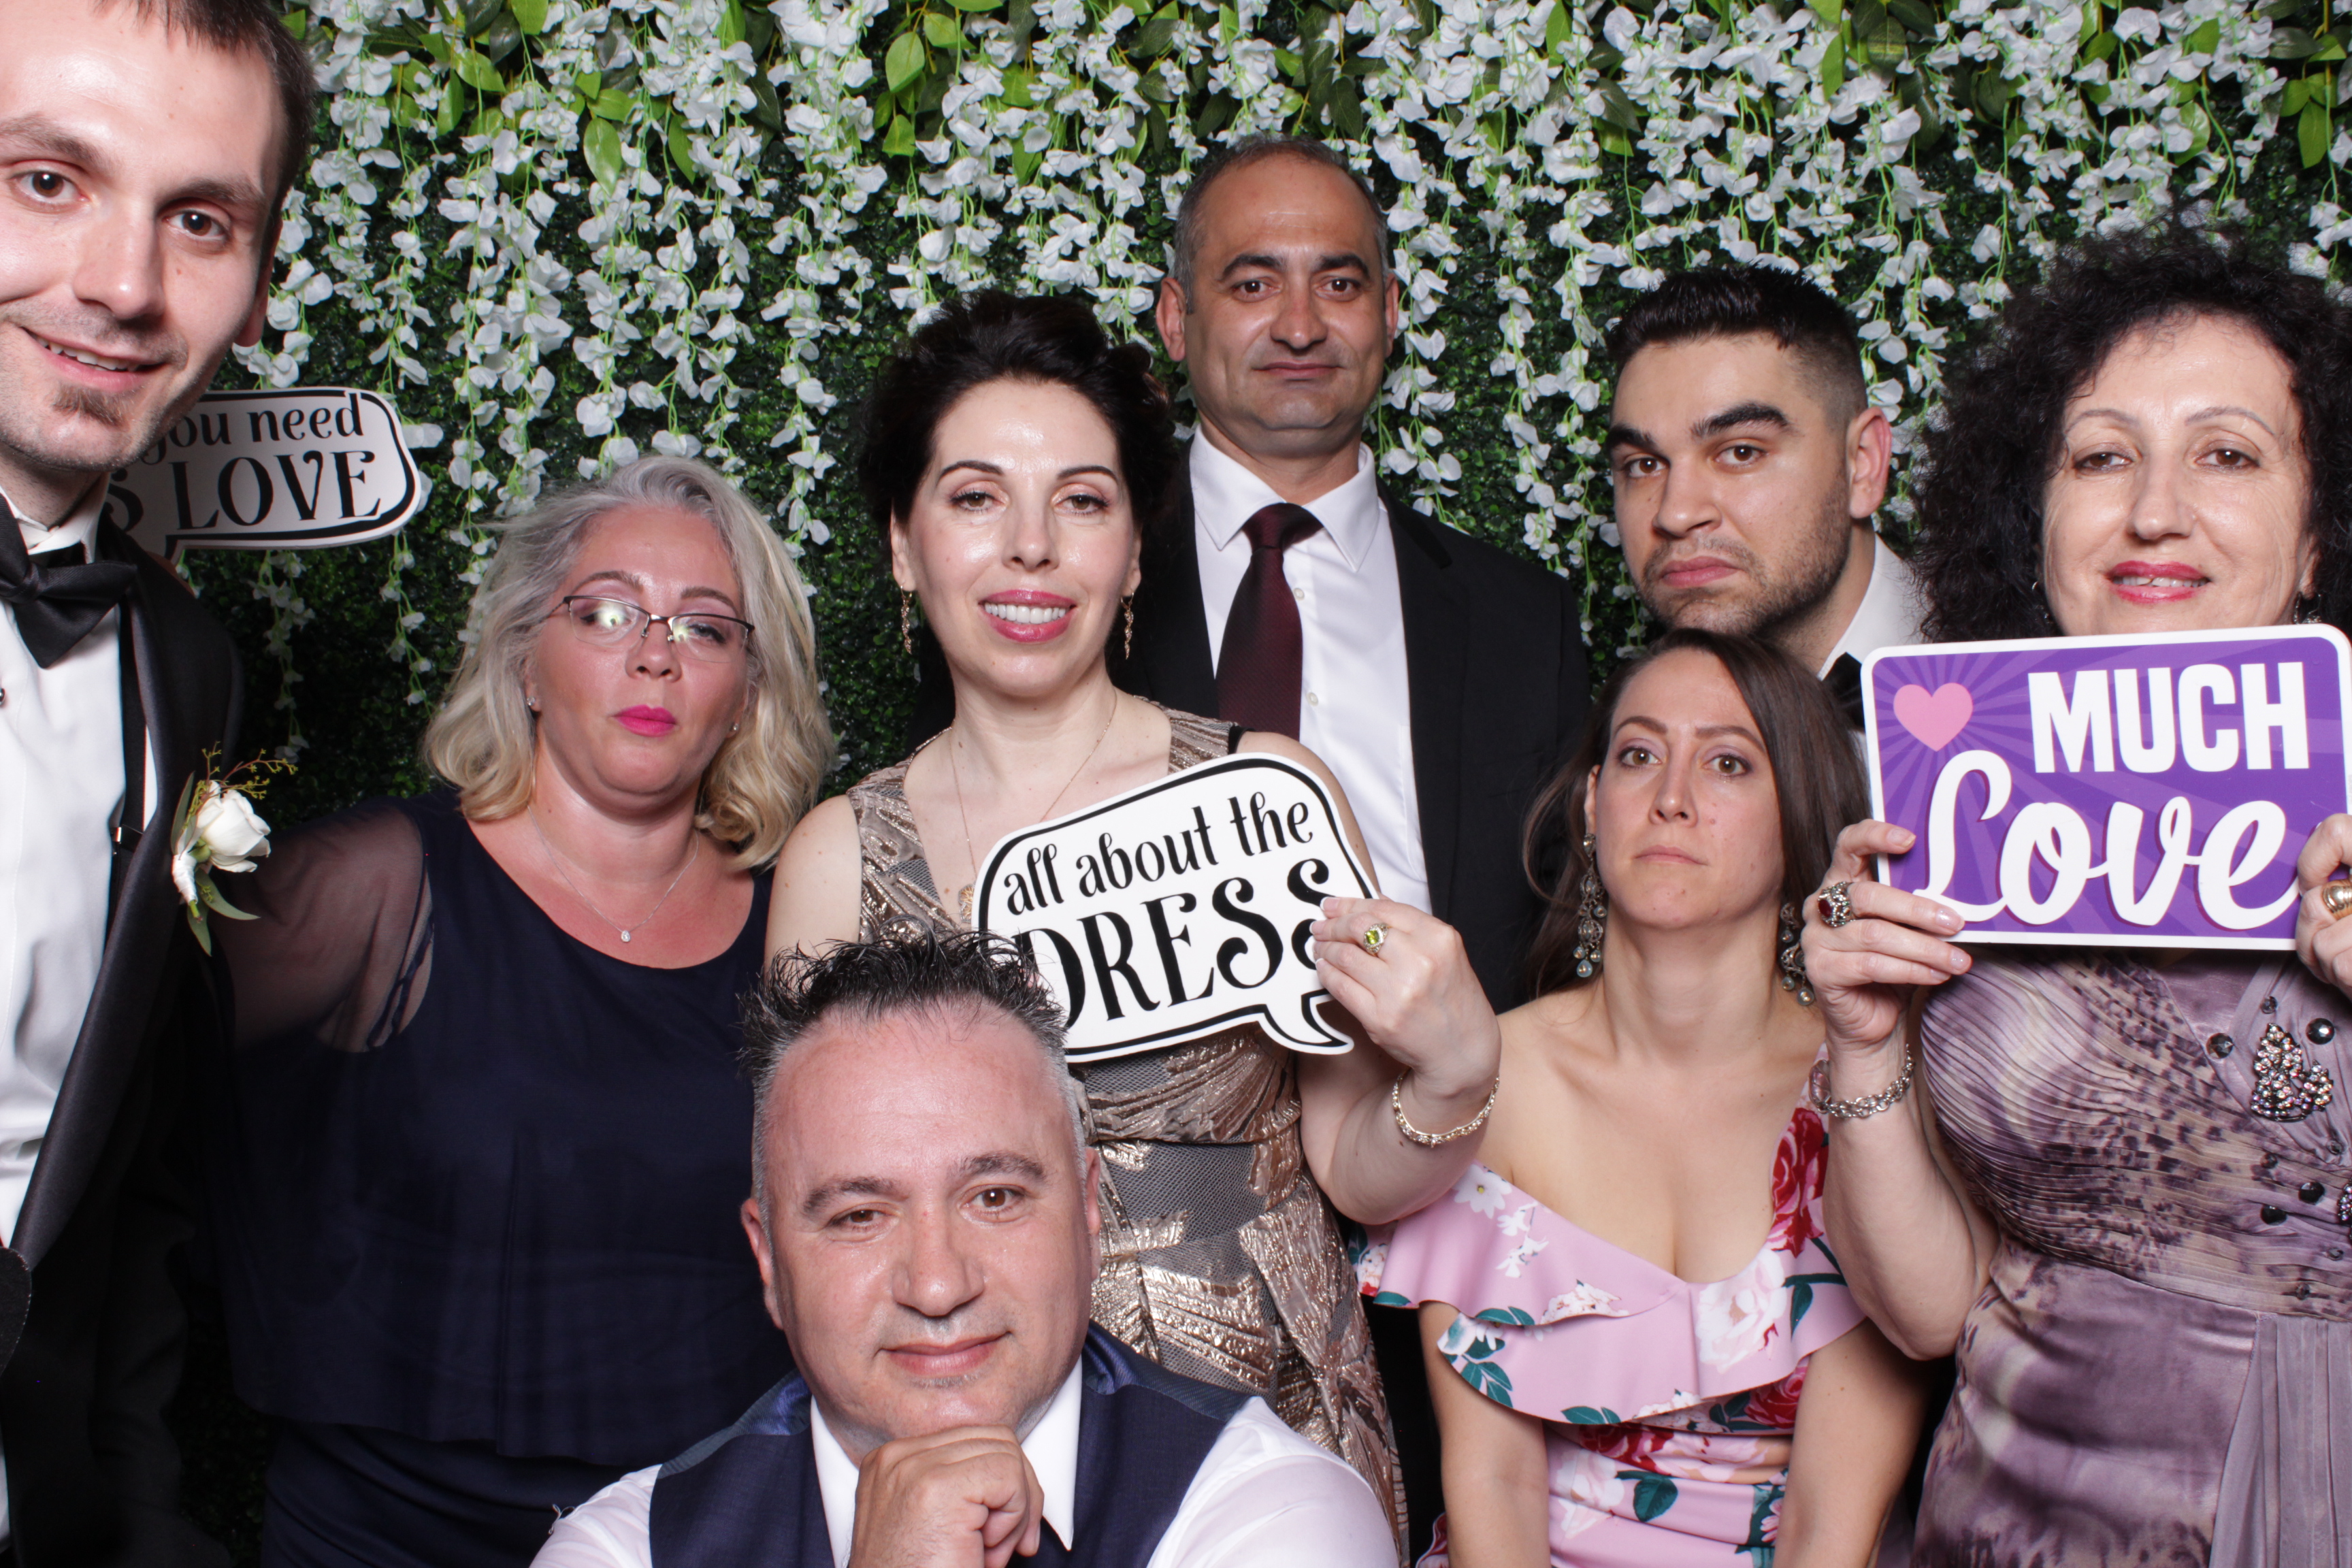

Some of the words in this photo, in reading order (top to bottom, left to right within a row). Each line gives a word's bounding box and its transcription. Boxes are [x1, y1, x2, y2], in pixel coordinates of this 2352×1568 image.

[247, 392, 364, 443] need
[168, 449, 381, 530] LOVE
[2027, 661, 2310, 774] MUCH
[1004, 843, 1065, 915] all
[1075, 805, 1220, 898] about
[1226, 791, 1314, 858] the
[1912, 749, 2300, 931] Love
